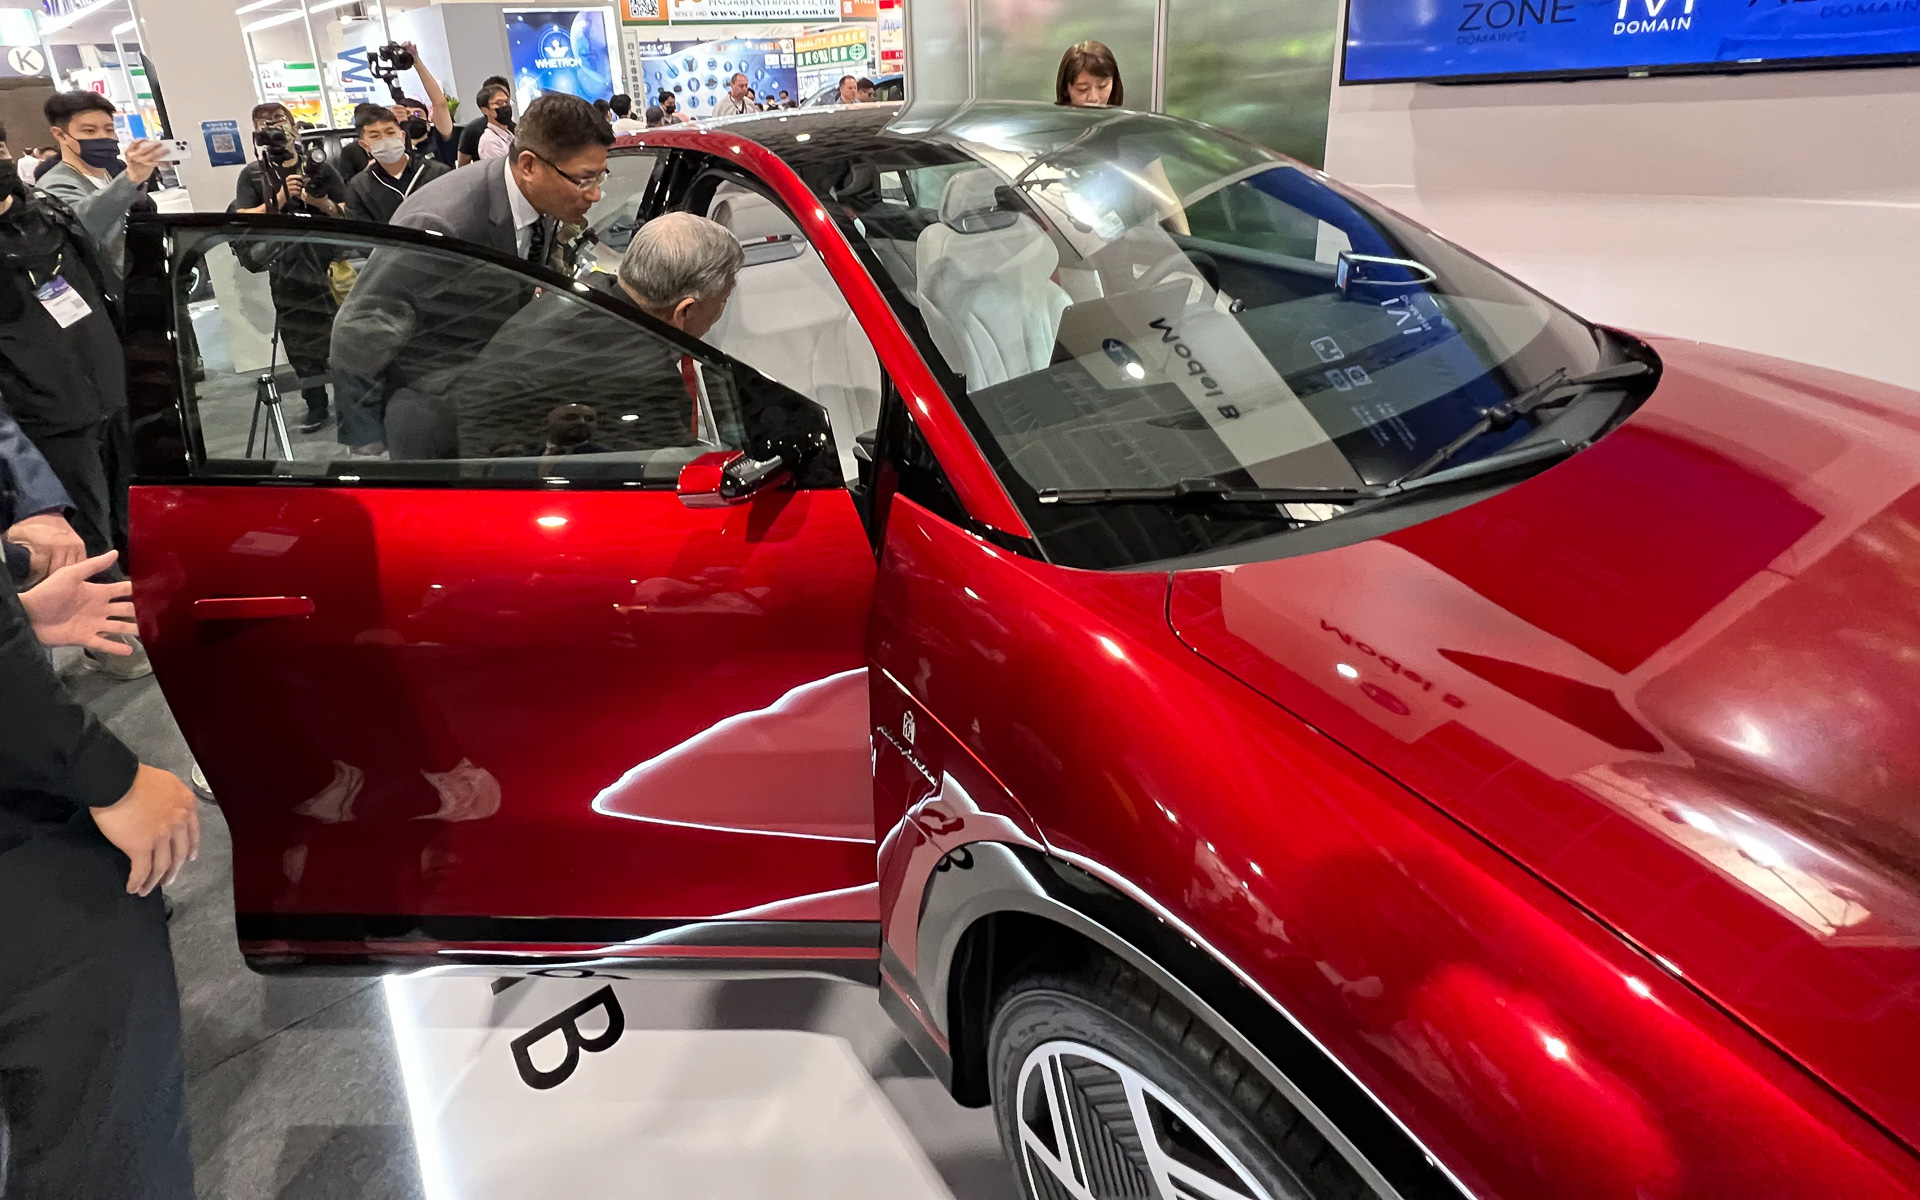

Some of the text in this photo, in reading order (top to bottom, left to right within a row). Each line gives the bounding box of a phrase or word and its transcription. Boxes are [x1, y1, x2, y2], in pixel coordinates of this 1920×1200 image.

[1457, 0, 1576, 32] ZONE
[1613, 17, 1691, 35] DOMAIN
[15, 49, 39, 71] K
[535, 57, 582, 69] WHETRON
[510, 983, 626, 1090] B
